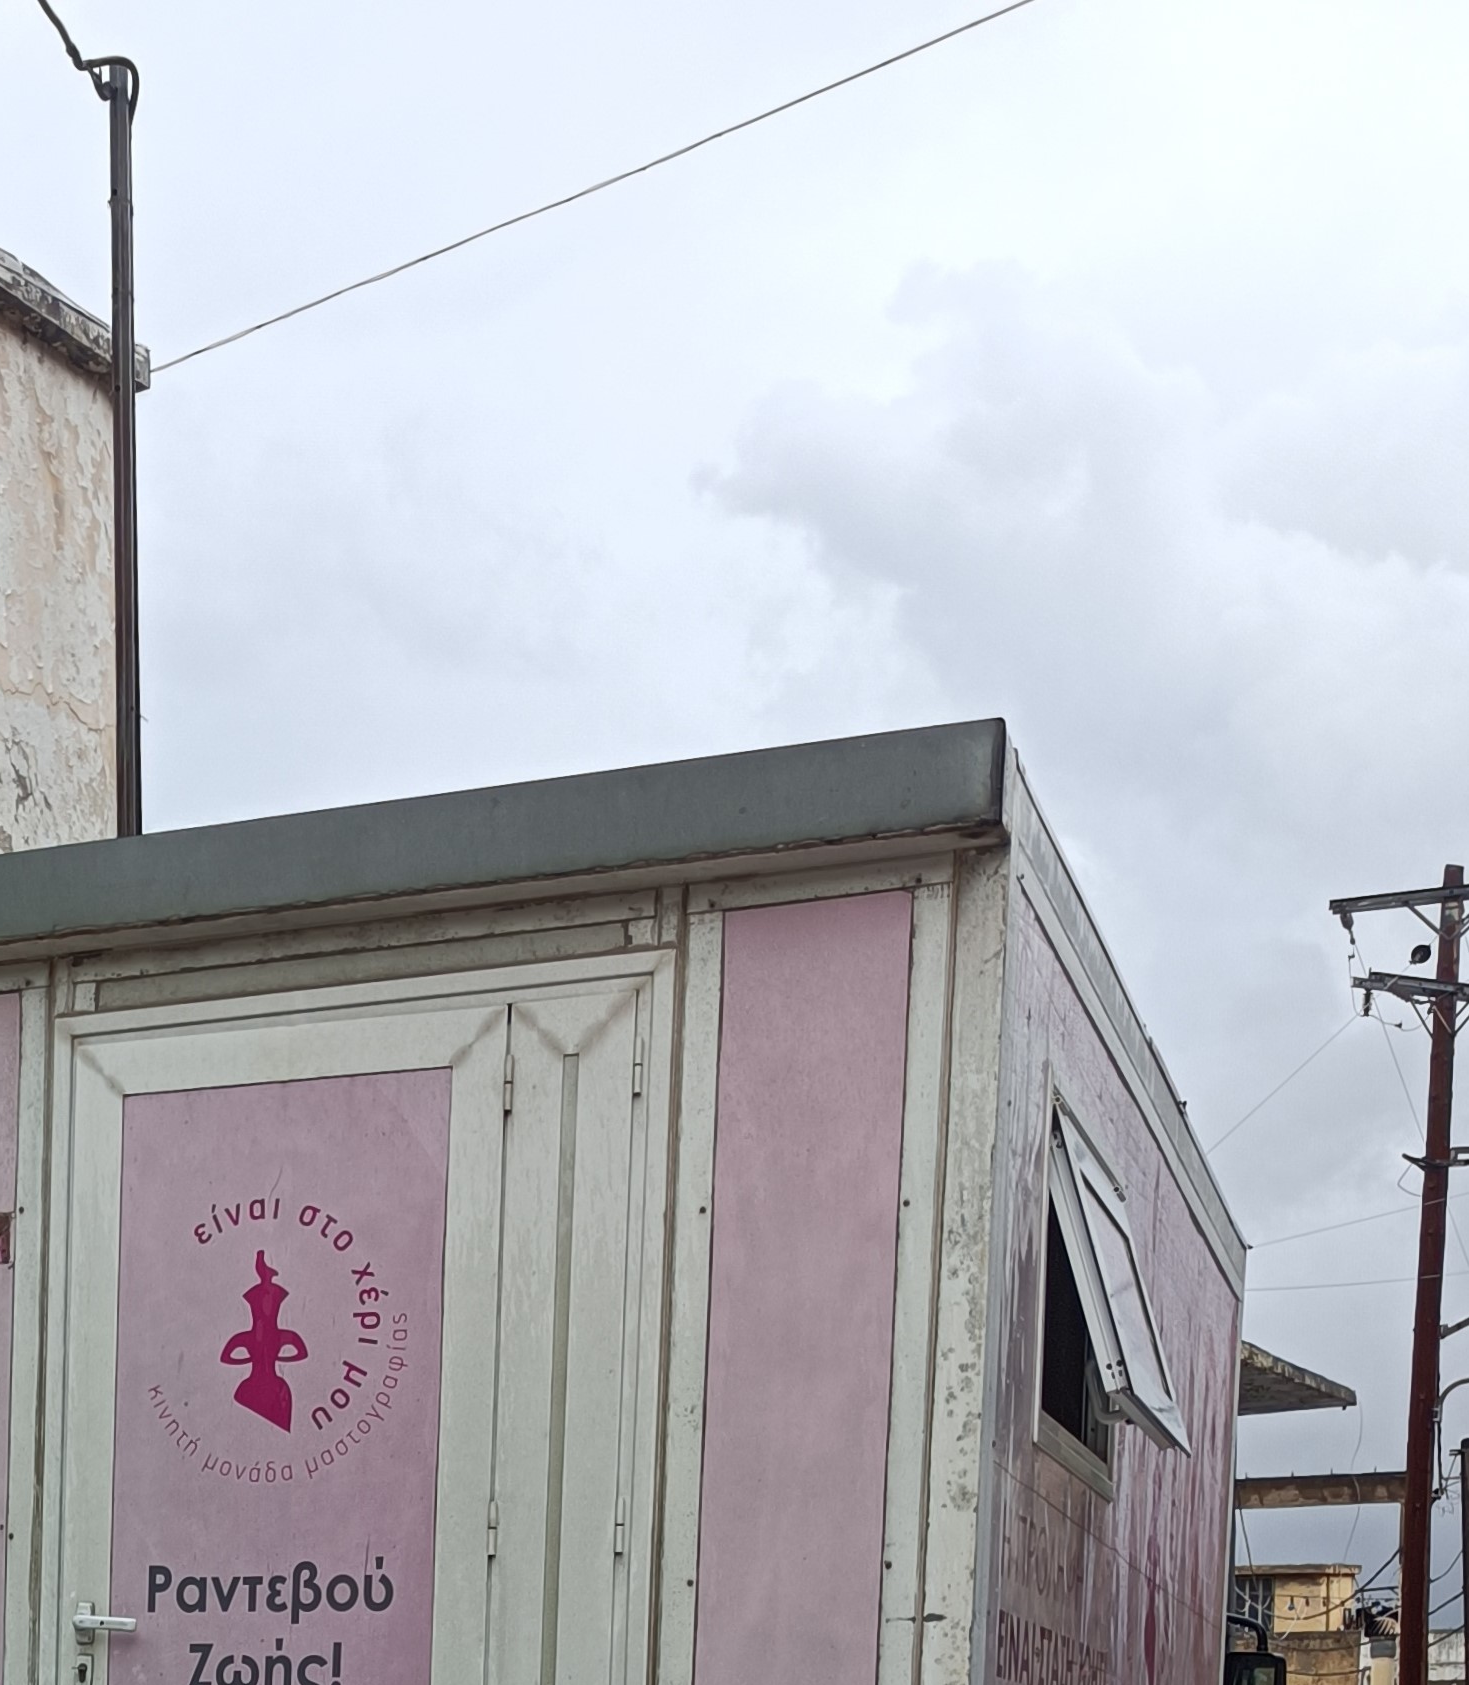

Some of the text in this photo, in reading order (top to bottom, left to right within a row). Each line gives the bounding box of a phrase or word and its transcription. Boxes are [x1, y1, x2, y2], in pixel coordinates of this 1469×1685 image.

[147, 1312, 408, 1483] κινητή μονάδα μαστογραφίας
[193, 1198, 389, 1430] είναι στο χέρι μου
[147, 1556, 394, 1624] Ραντεβού
